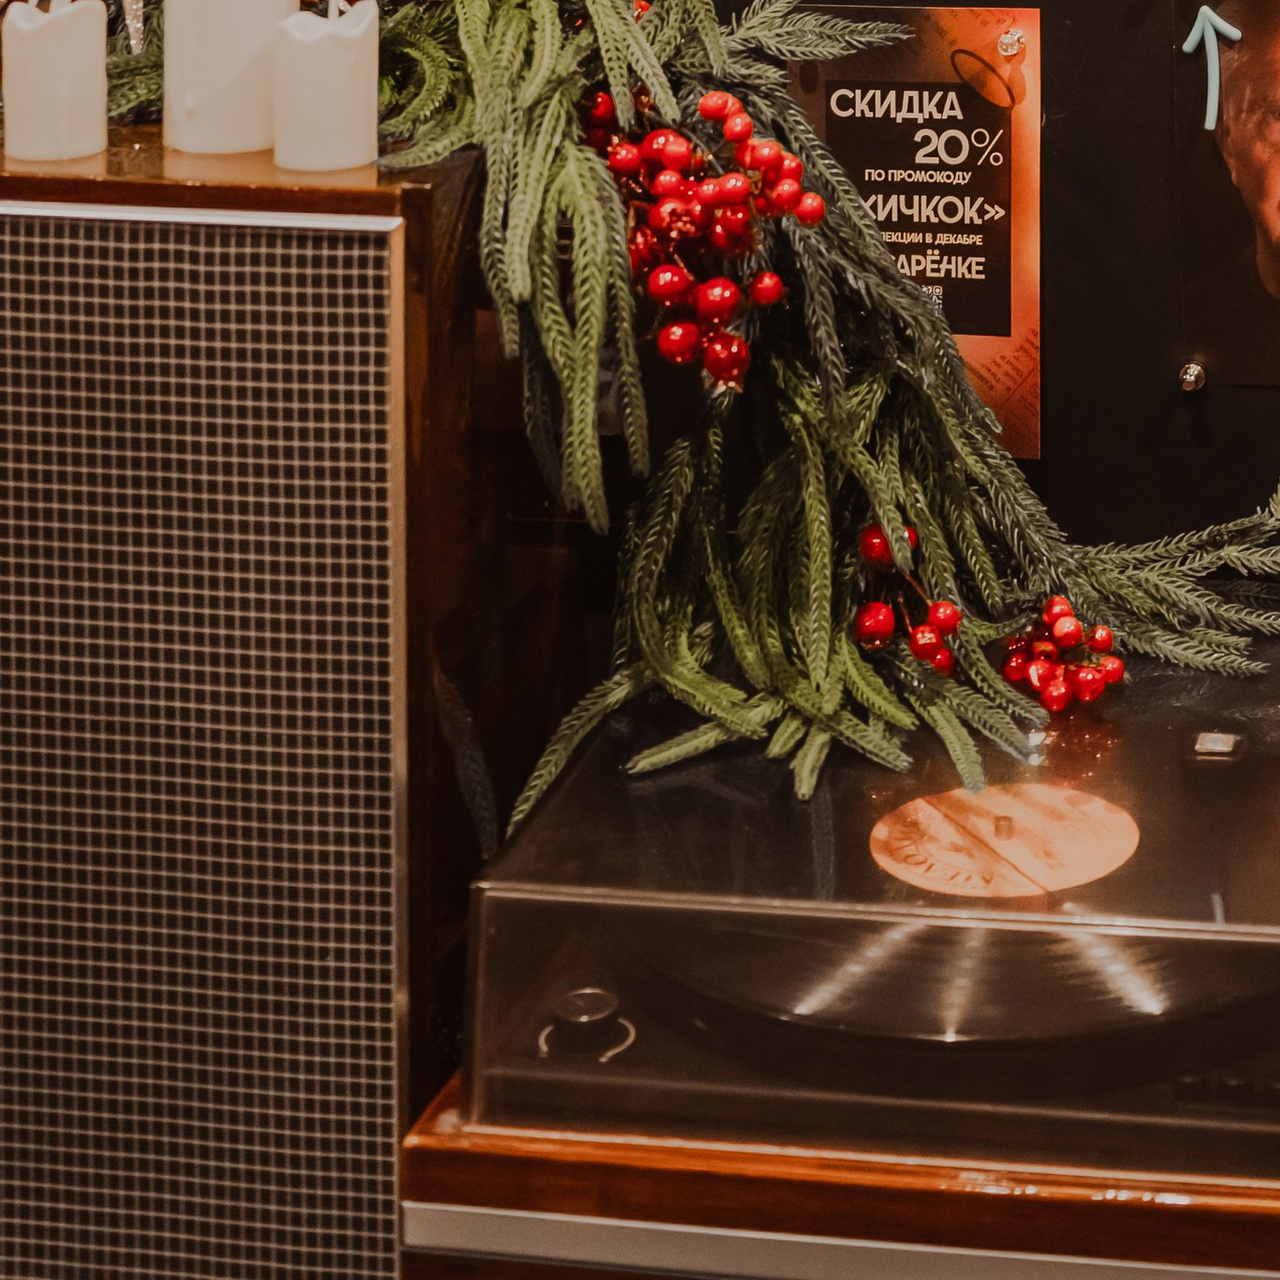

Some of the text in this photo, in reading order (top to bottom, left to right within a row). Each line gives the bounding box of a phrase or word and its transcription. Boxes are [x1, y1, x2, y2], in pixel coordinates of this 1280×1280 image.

[829, 88, 964, 124] СКИДКА
[913, 128, 1004, 166] 20%
[864, 168, 972, 185] ПО ПРОМОКОДУ
[925, 232, 933, 244] В
[934, 233, 984, 246] ДЕКАБРЕ
[890, 248, 986, 280] АРЁНКЕ
